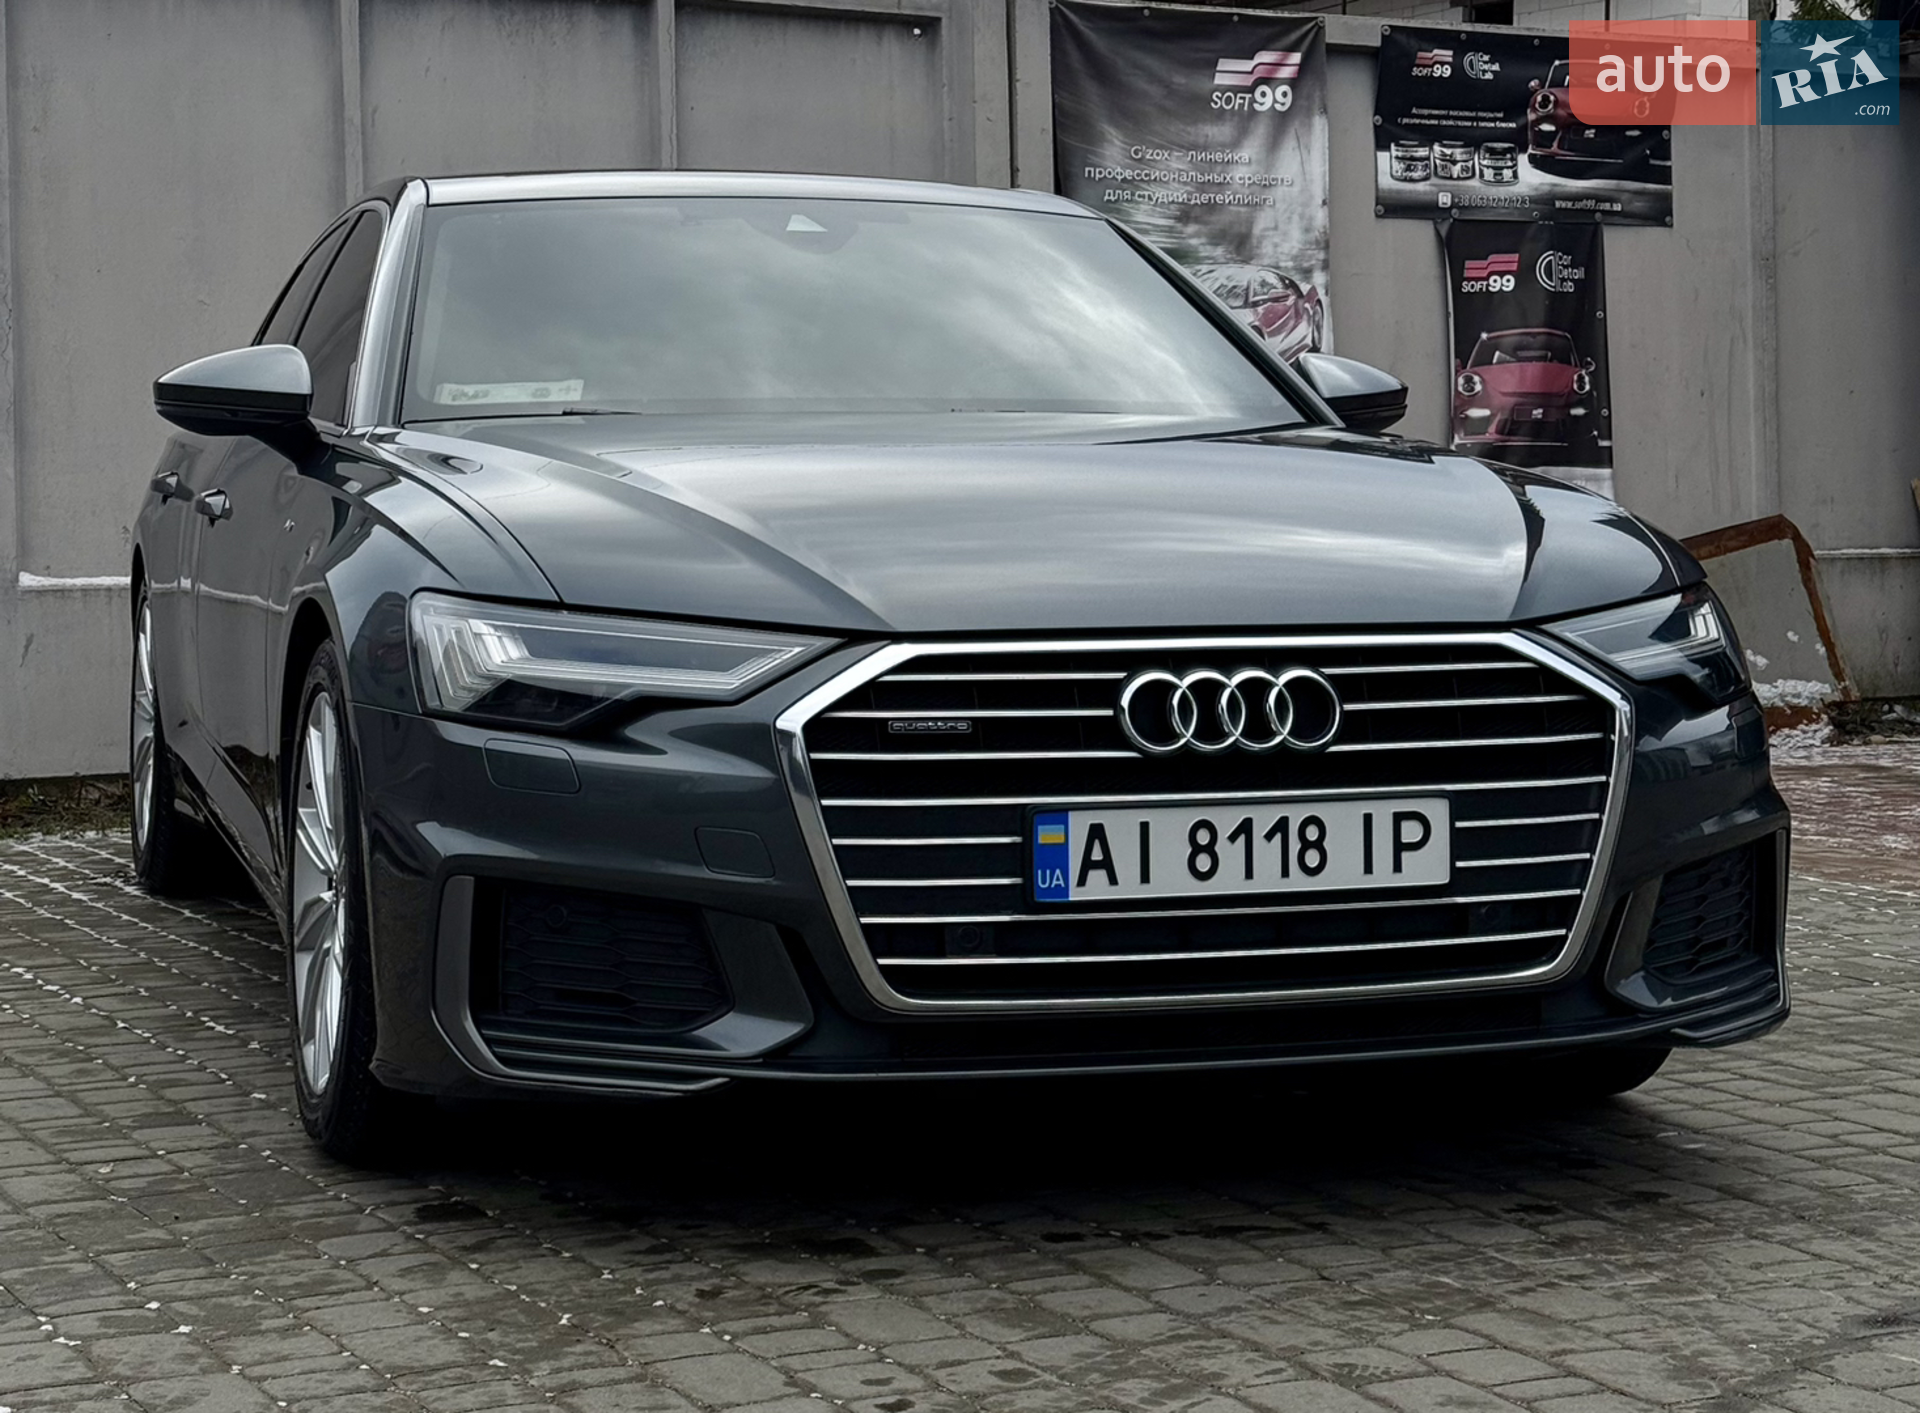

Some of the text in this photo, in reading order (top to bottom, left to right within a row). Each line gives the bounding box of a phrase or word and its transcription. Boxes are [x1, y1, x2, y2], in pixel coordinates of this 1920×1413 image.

[1478, 52, 1491, 61] Car
[1478, 62, 1501, 71] Detail
[1479, 71, 1494, 80] Lab
[1187, 148, 1249, 163] линейка
[1085, 166, 1292, 187] профессиональных средств
[1103, 189, 1274, 206] для студий детейлинга
[1557, 252, 1572, 265] Car
[1558, 266, 1585, 280] Detail
[1558, 280, 1575, 293] Lab
[892, 722, 968, 732] quattro
[1076, 810, 1432, 887] AI 8118 IP
[1038, 868, 1065, 889] UA
